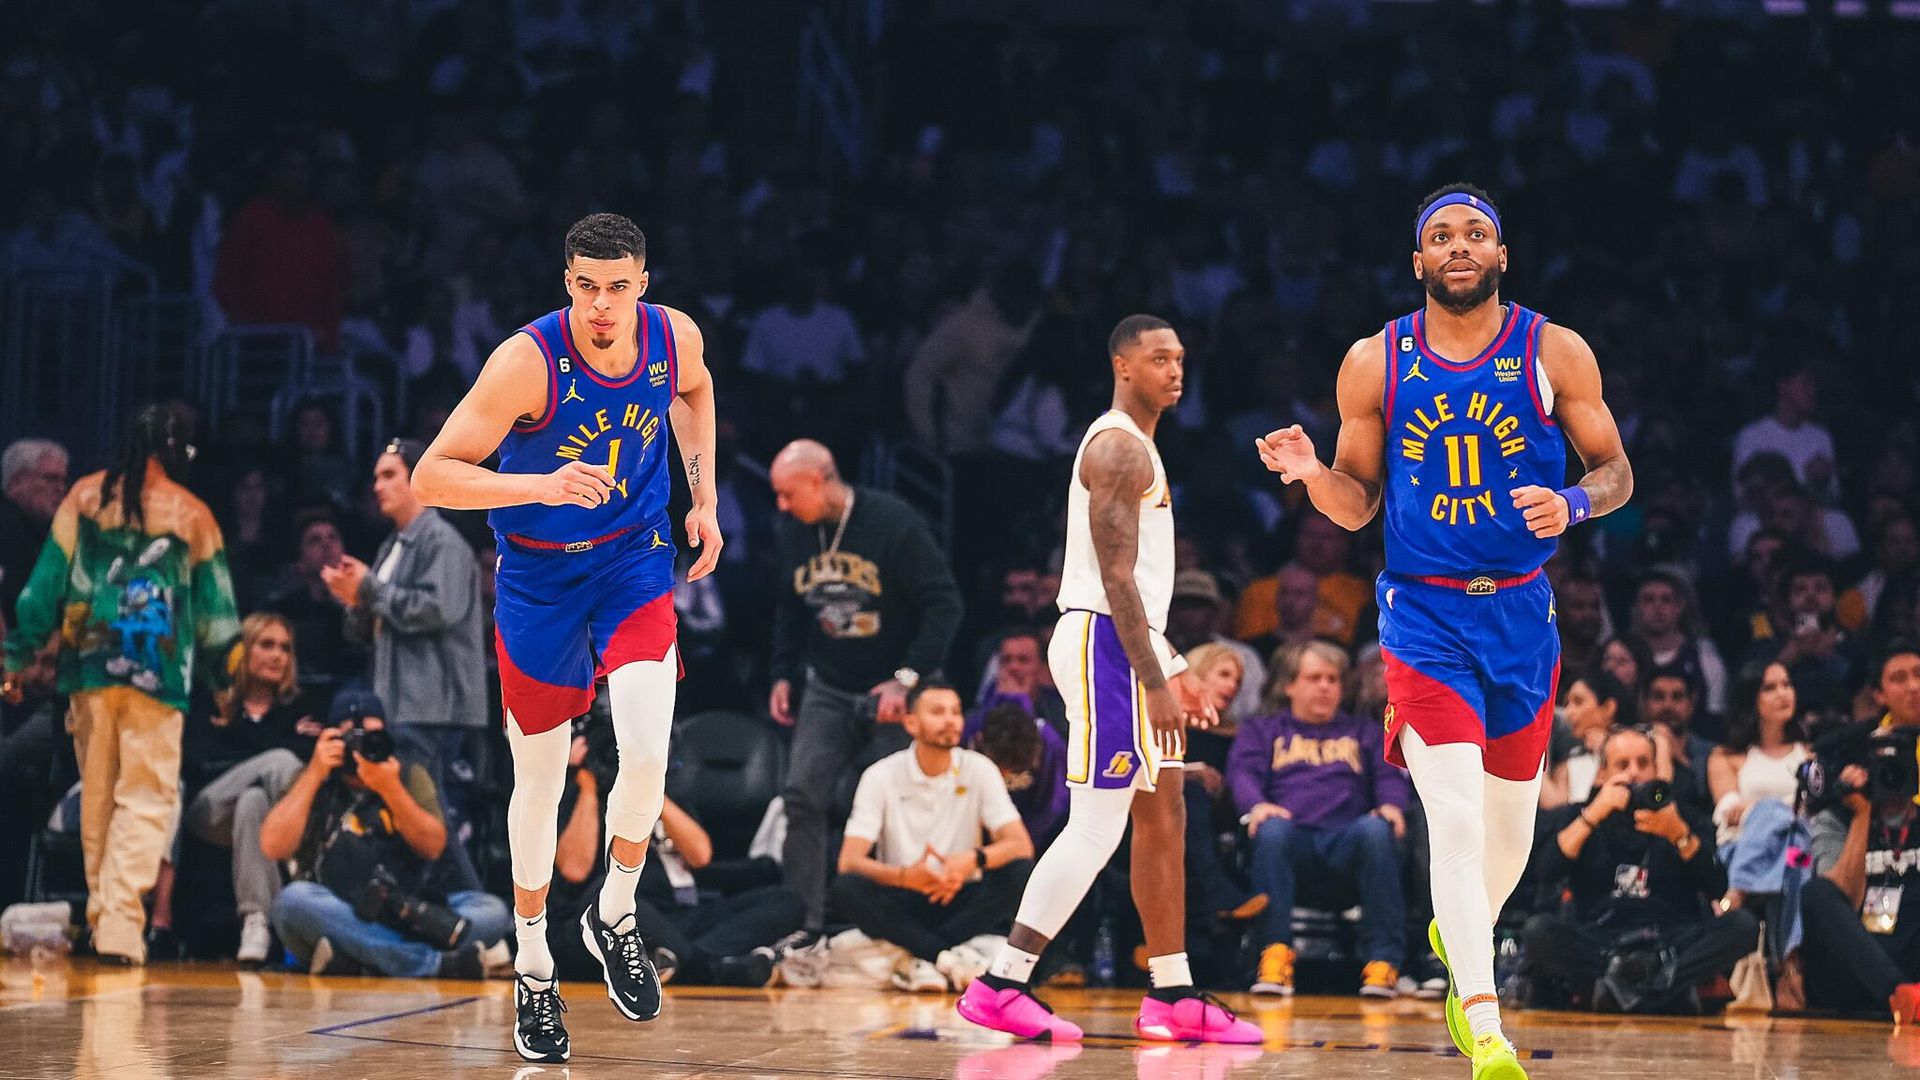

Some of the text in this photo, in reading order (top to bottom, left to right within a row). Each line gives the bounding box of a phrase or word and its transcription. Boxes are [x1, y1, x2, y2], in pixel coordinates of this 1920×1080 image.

[1401, 336, 1414, 352] 6
[559, 357, 571, 373] 6
[648, 360, 668, 376] WU
[1494, 356, 1521, 370] WU
[1494, 370, 1521, 378] Western
[556, 408, 612, 460] MILE
[1402, 392, 1525, 462] MILE HIGH
[608, 438, 622, 477] 1
[1444, 435, 1481, 487] 11
[1431, 490, 1497, 525] CITY
